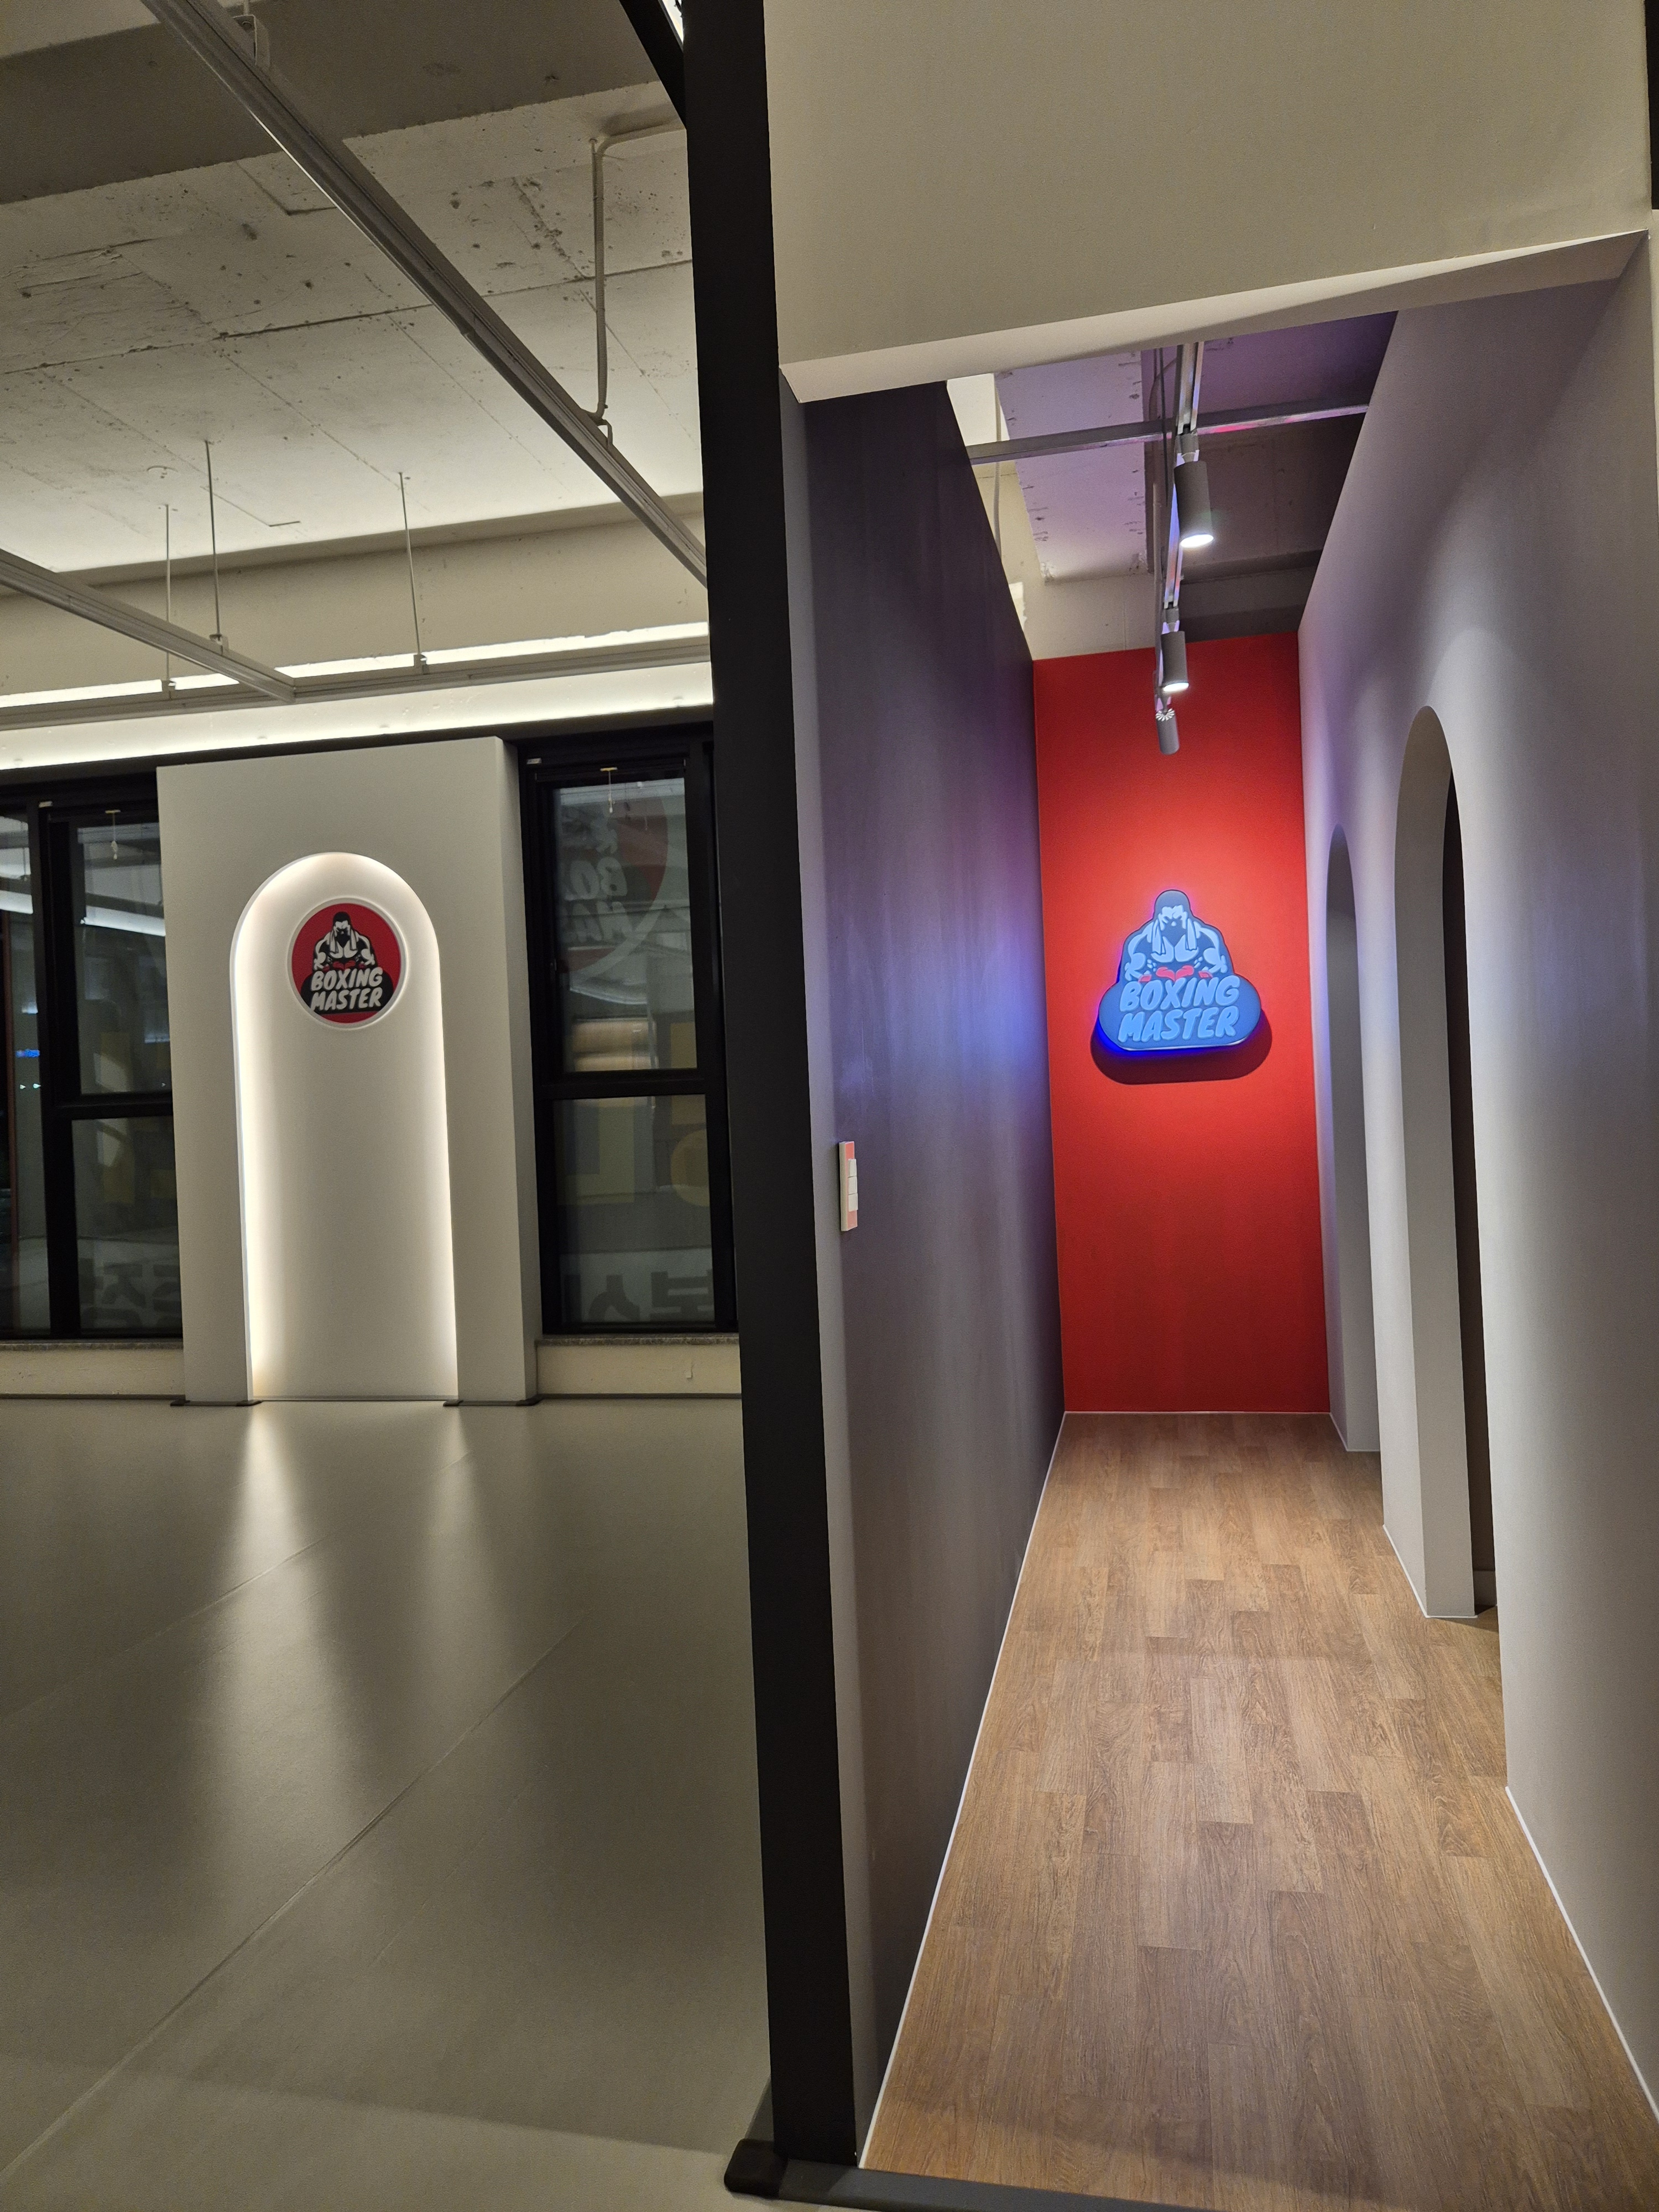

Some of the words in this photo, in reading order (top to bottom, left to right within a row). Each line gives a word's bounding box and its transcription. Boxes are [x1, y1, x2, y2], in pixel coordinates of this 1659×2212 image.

[311, 968, 383, 991] BOXING
[1120, 975, 1240, 1011] BOXING
[311, 988, 383, 1011] MASTER
[1118, 1006, 1239, 1042] MASTER
